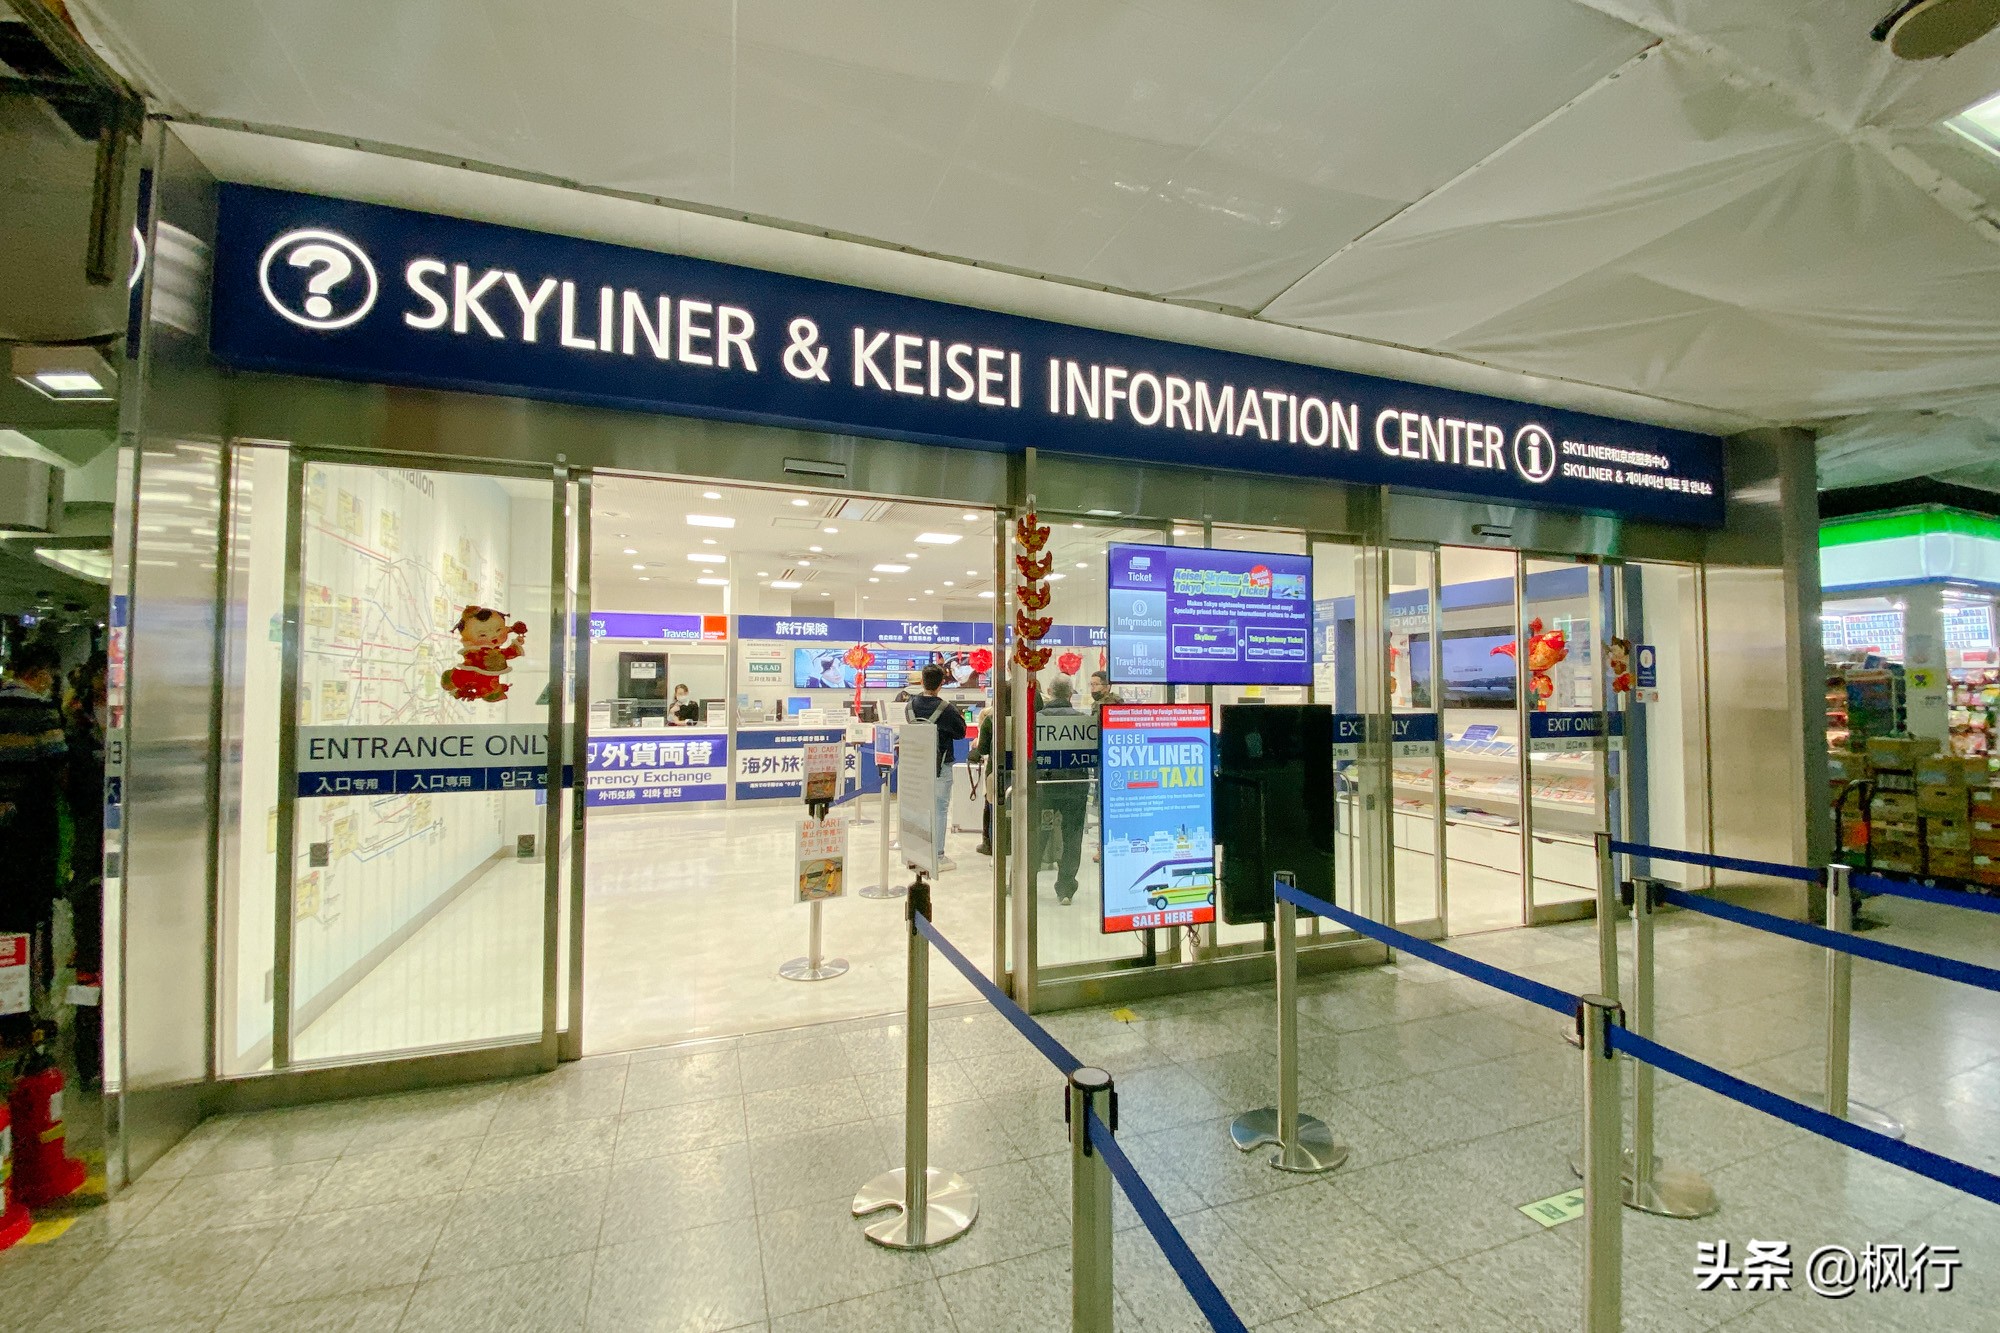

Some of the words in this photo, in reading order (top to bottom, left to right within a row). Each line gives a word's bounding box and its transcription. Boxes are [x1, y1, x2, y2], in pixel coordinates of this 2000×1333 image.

[405, 259, 758, 372] SKYLINER
[783, 318, 830, 382] &
[853, 327, 1020, 408] KEISEI
[1050, 359, 1358, 451] INFORMATION
[1375, 409, 1506, 470] CENTER
[1563, 462, 1612, 482] SKYLINER
[1615, 470, 1623, 483] &
[1128, 572, 1152, 582] Ticket
[1174, 569, 1203, 582] Keisei
[1204, 570, 1242, 583] Skyliner
[1174, 582, 1203, 596] Tokyo
[1203, 583, 1240, 598] Subway
[1241, 586, 1269, 597] Ticket
[775, 621, 828, 636] 旅行保険
[901, 622, 938, 635] Ticket
[1117, 618, 1162, 628] Information
[662, 629, 700, 639] Travelex
[1115, 657, 1137, 667] Travel
[1137, 658, 1165, 669] Relating
[1128, 666, 1153, 676] Service
[1547, 718, 1571, 732] EXIT
[1108, 734, 1145, 745] KEISEI
[309, 735, 474, 760] ENTRANCE
[601, 741, 712, 768] 外貨両替
[808, 746, 817, 754] NO
[821, 745, 839, 753] CART
[1108, 744, 1204, 767] SKYLINER
[500, 772, 533, 787] 입구
[643, 771, 712, 783] Exchange
[1110, 770, 1125, 790] &
[1127, 769, 1158, 781] TEITO
[1158, 766, 1204, 788] TAXI
[642, 788, 662, 799] 외화
[663, 787, 682, 798] 환전
[803, 821, 815, 830] NO
[820, 819, 841, 829] CART
[1132, 912, 1161, 928] SALE
[1164, 910, 1194, 925] HERE
